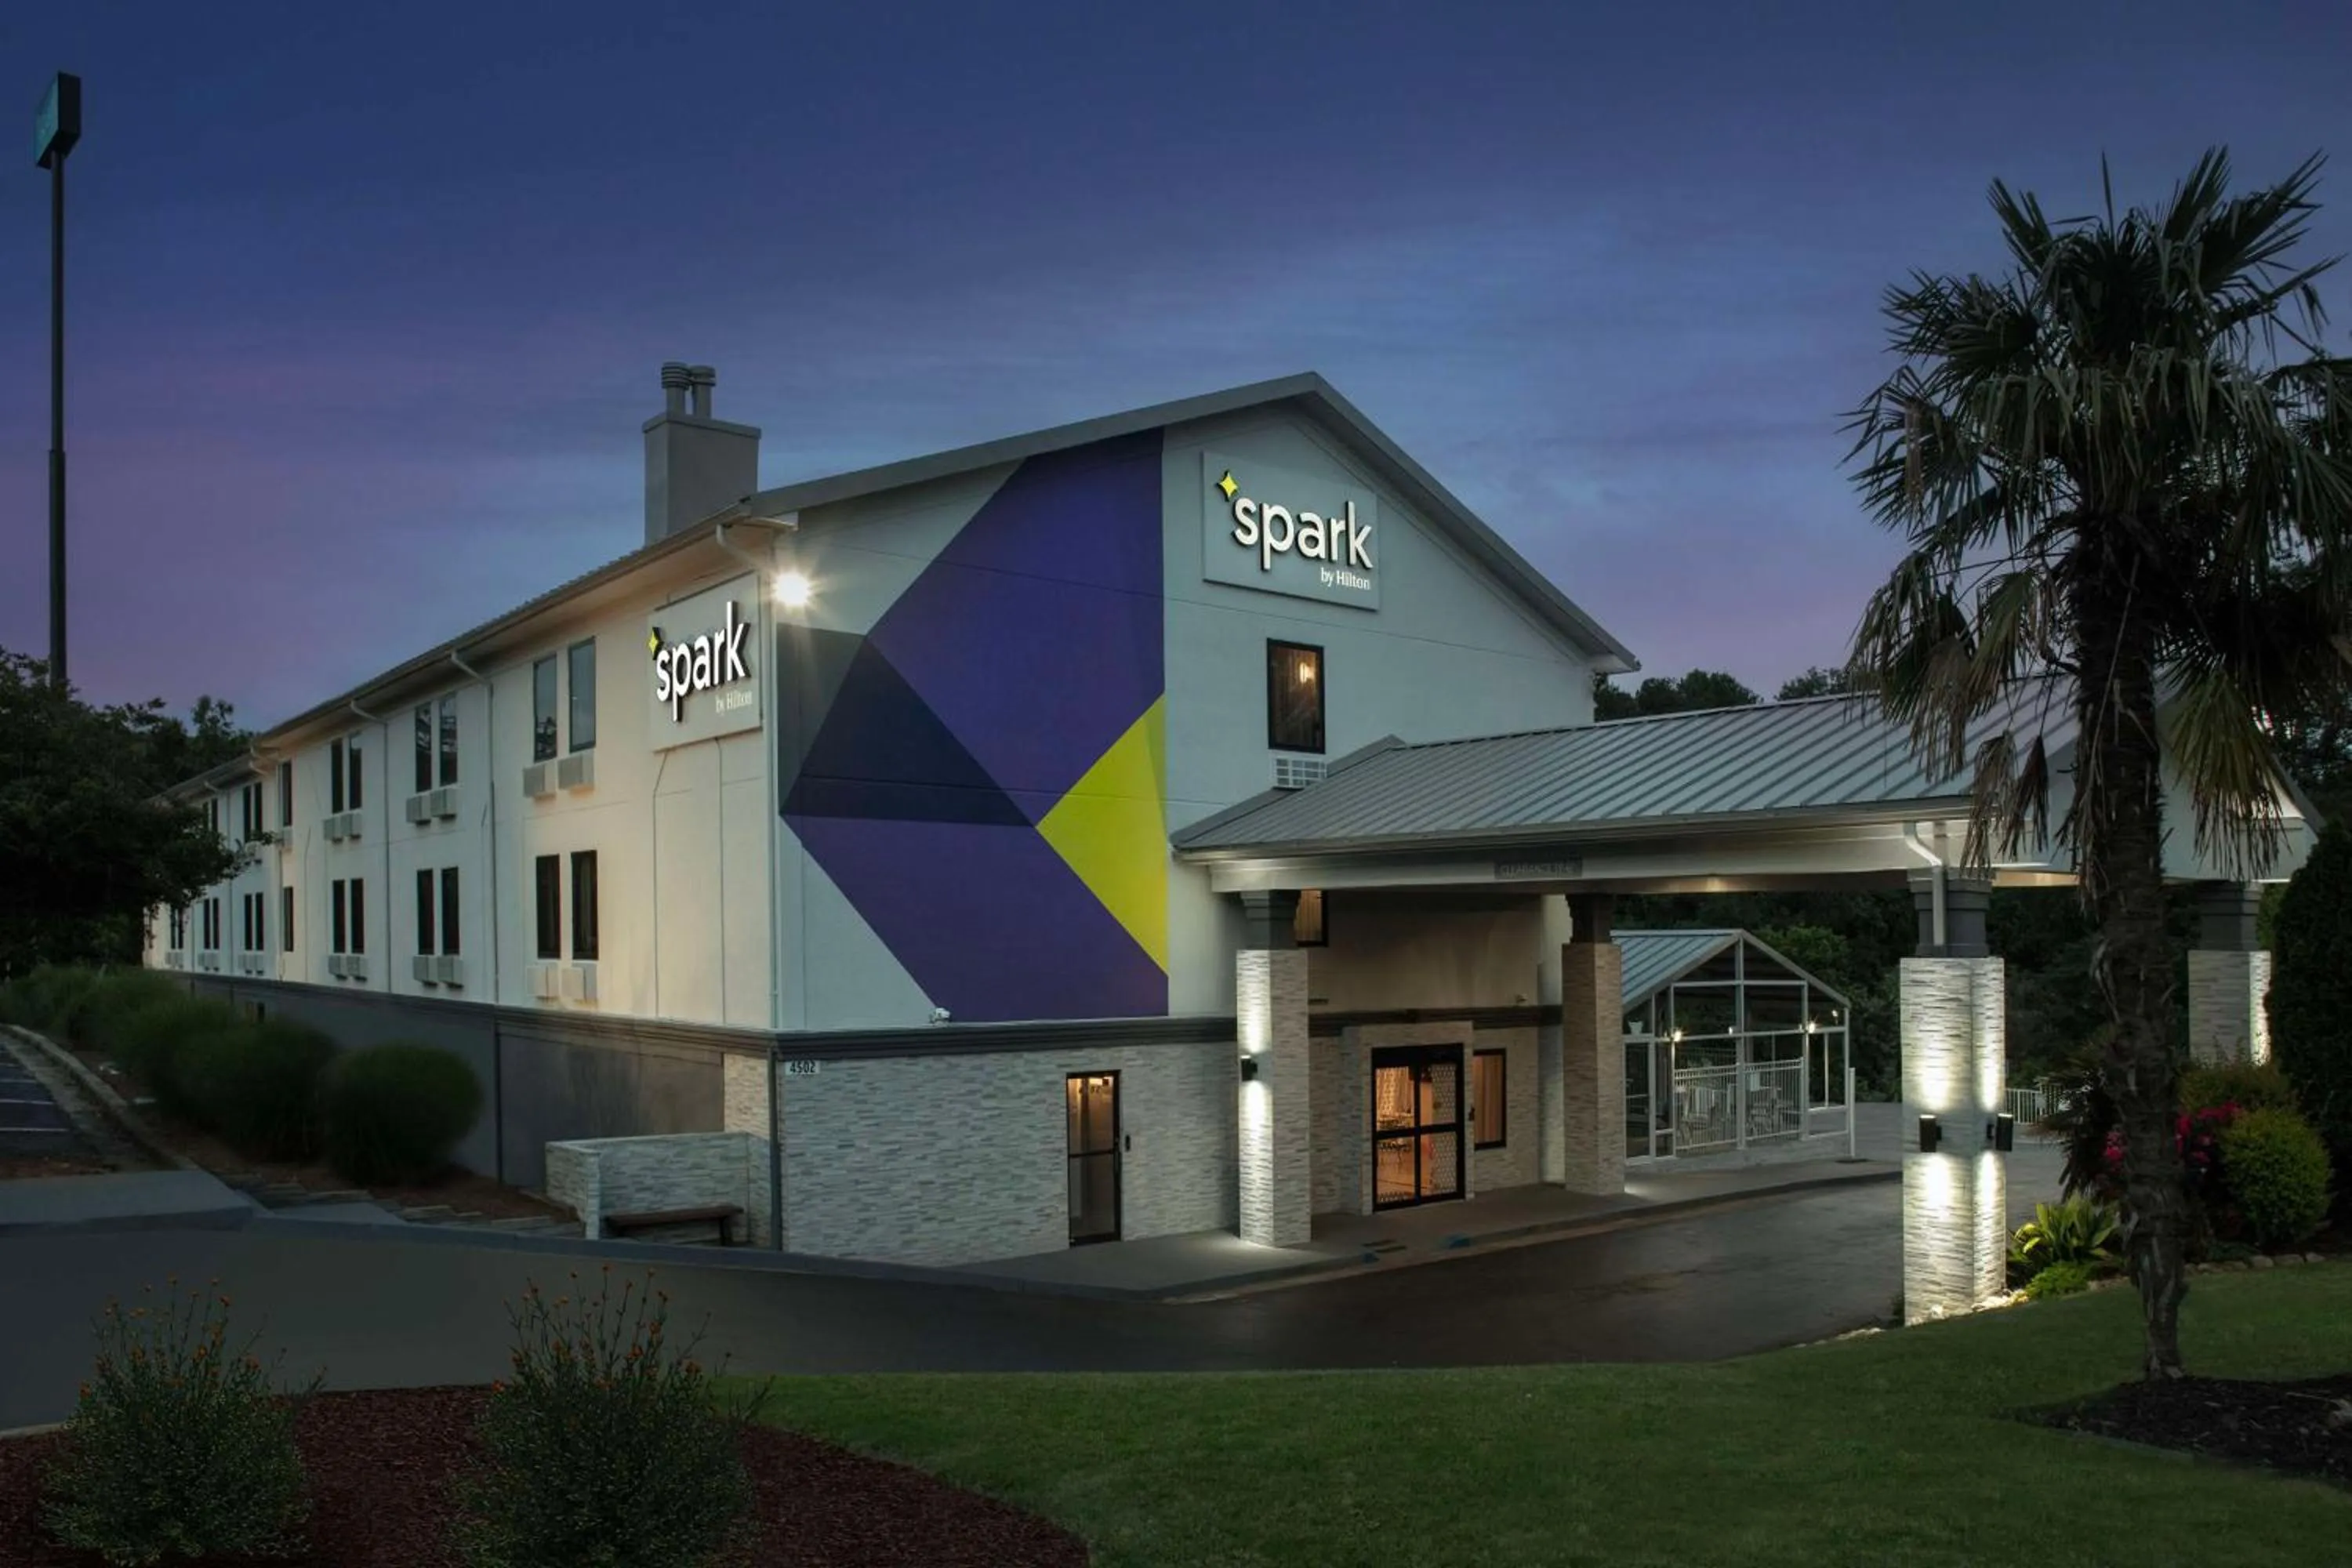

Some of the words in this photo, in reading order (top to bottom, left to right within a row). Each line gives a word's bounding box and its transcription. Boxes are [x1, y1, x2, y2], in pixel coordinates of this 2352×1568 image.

[1232, 497, 1374, 571] spark
[1320, 567, 1334, 587] by
[1336, 570, 1370, 590] Hilton
[656, 600, 746, 722] spark
[726, 690, 753, 710] Hilton
